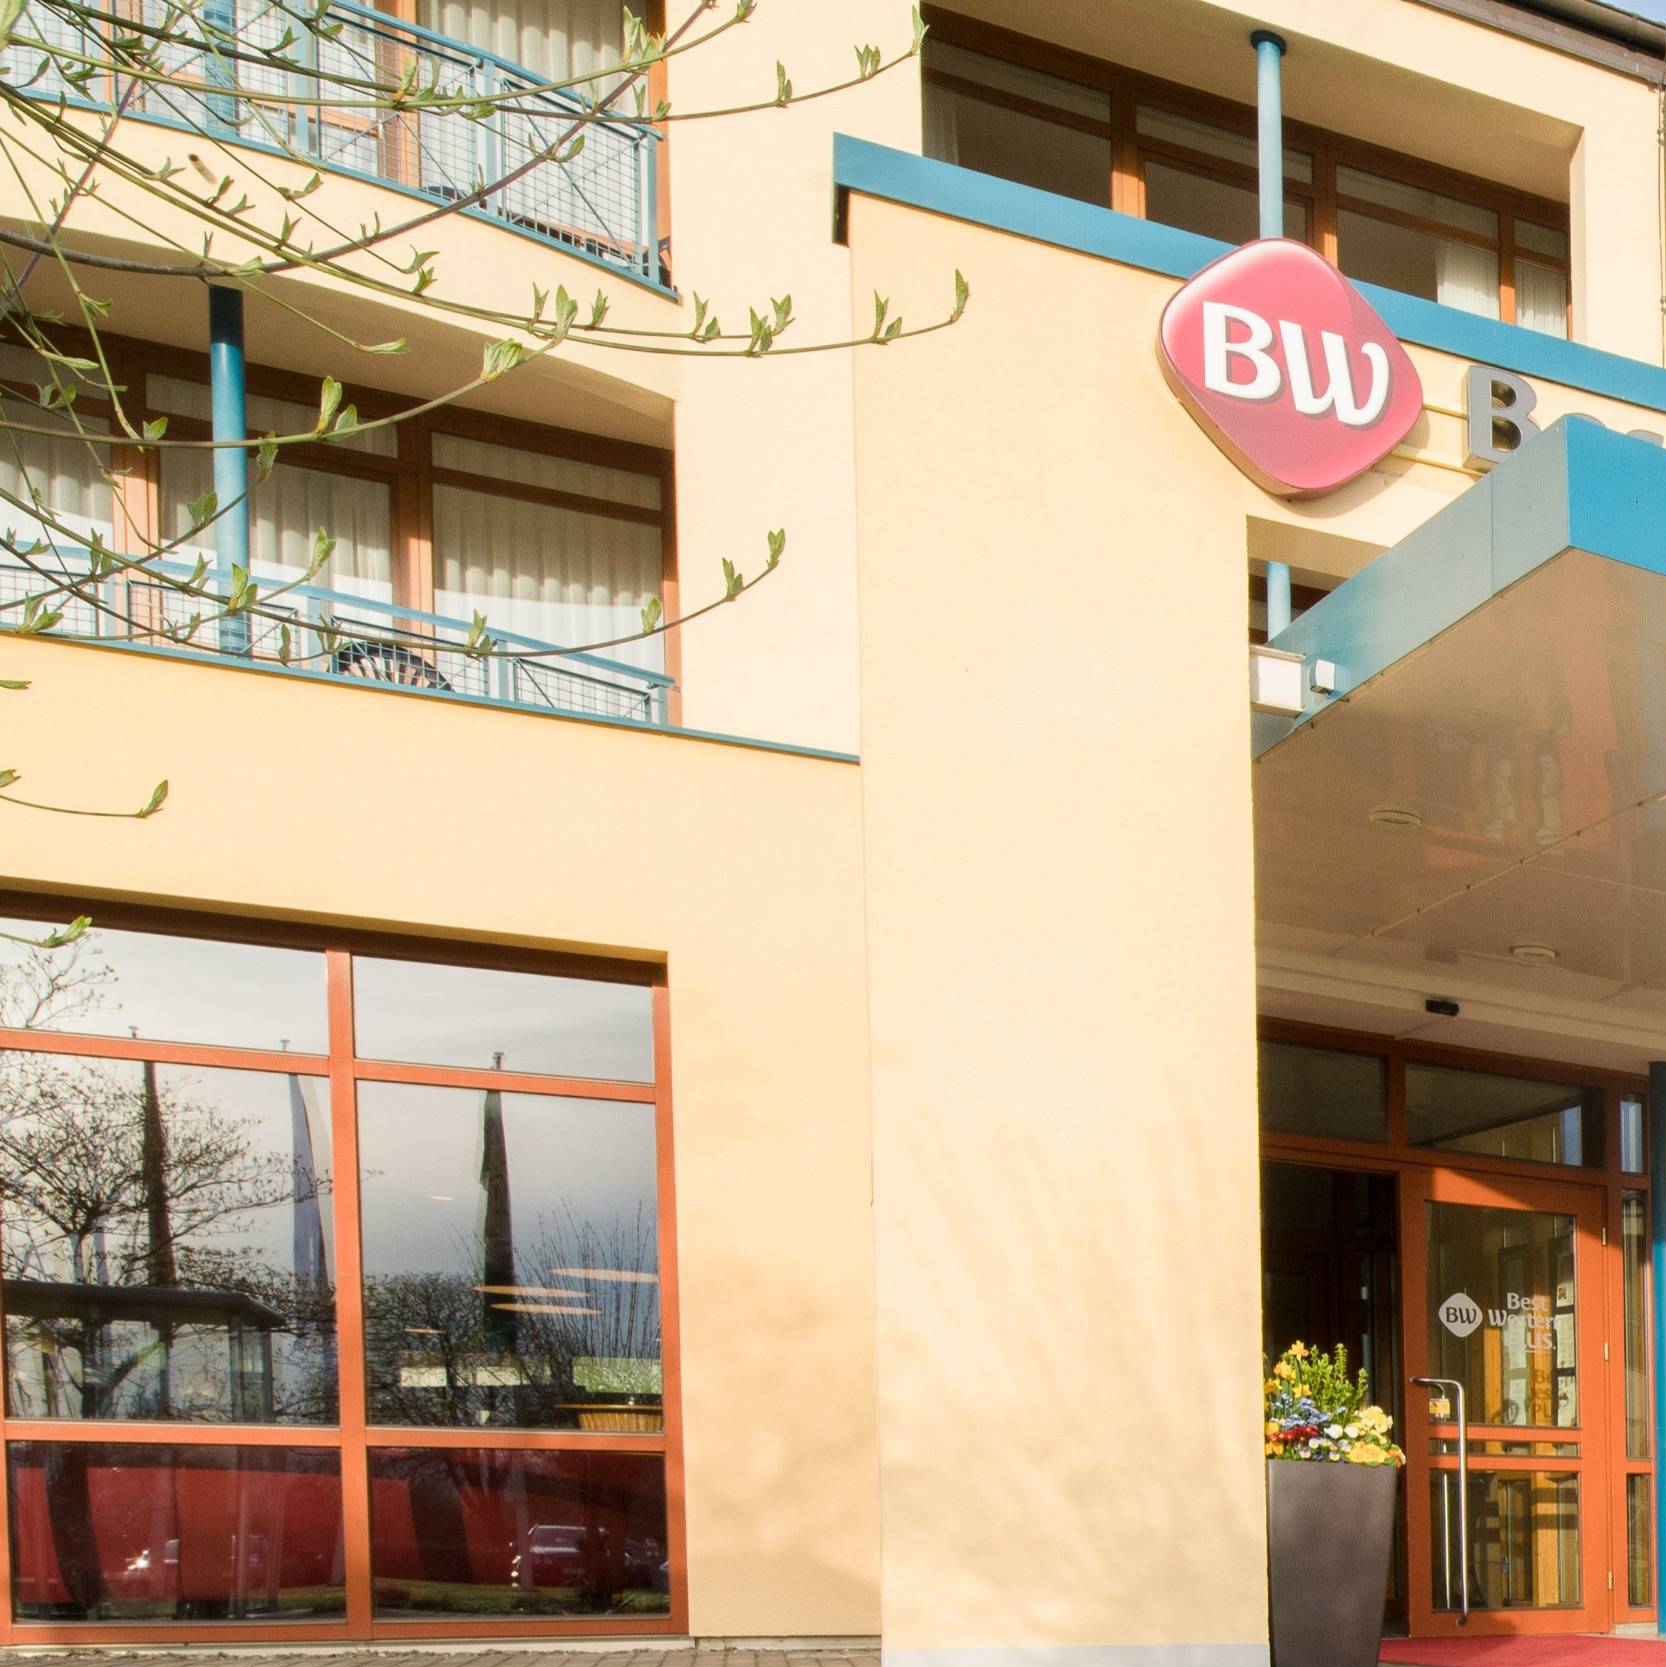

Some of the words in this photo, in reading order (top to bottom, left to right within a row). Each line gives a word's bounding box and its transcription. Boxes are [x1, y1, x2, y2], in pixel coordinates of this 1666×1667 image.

[1203, 301, 1390, 426] BW
[1506, 1292, 1548, 1312] Best
[1445, 1306, 1477, 1325] BW
